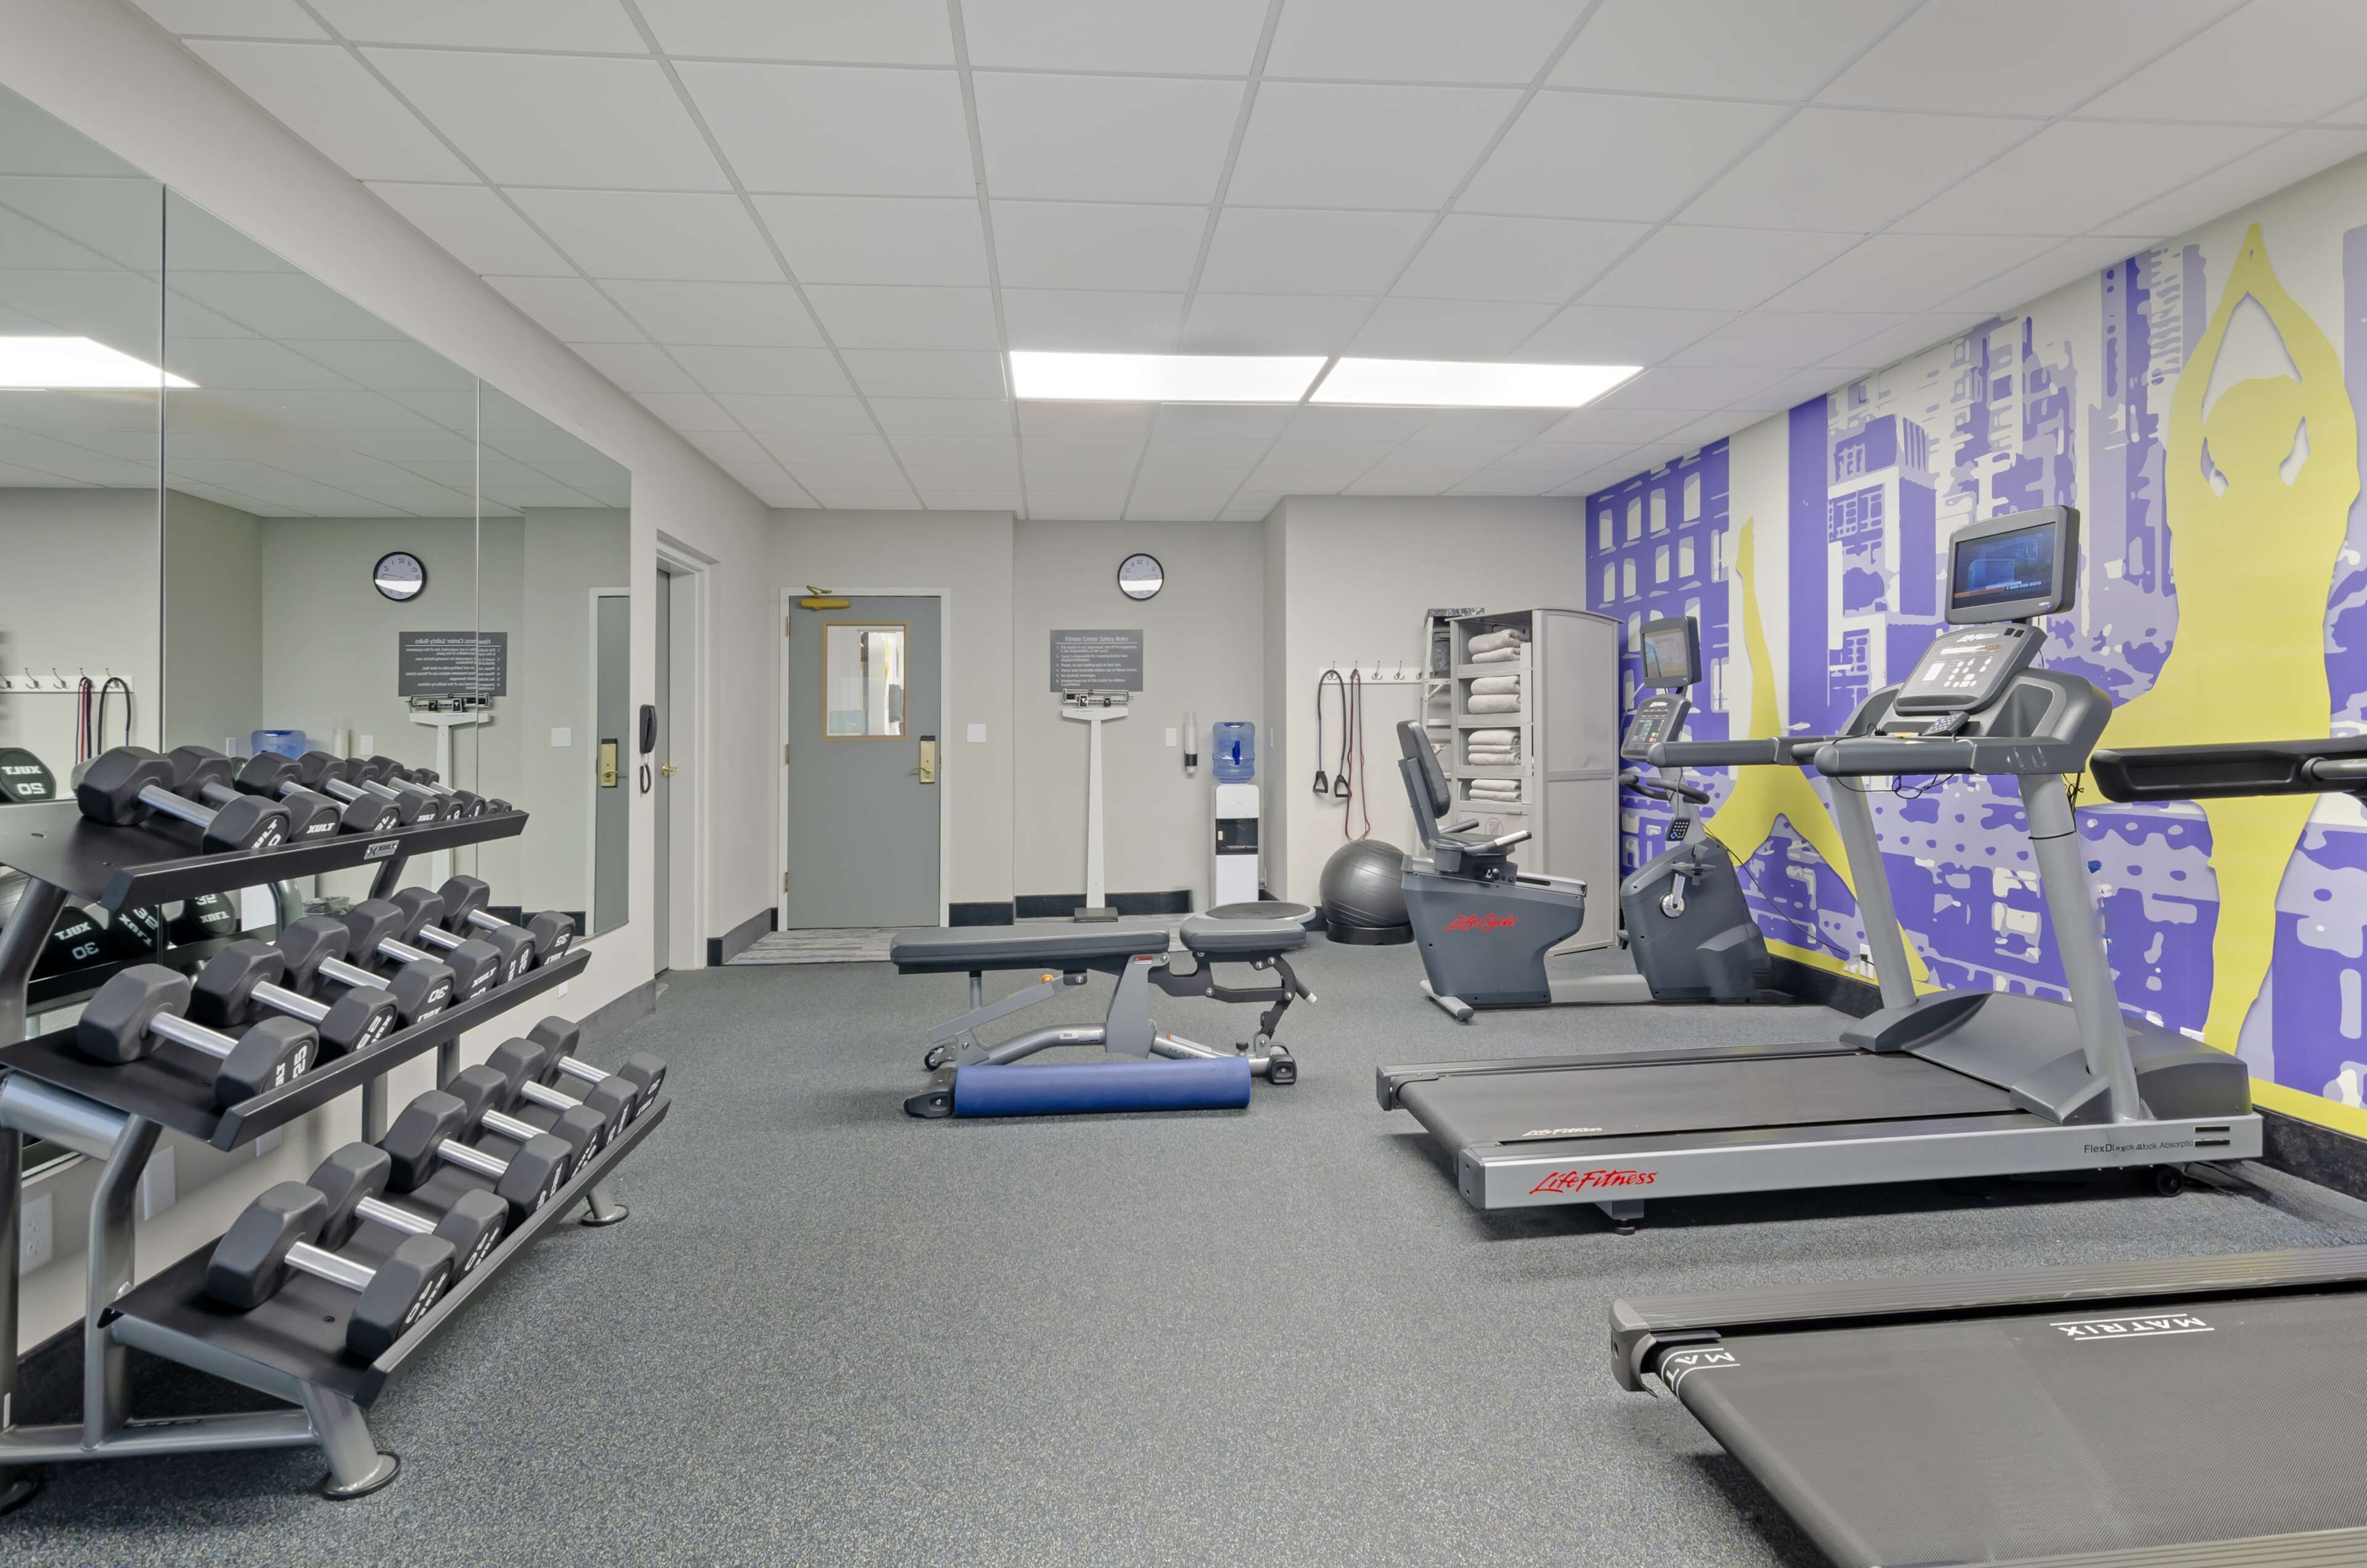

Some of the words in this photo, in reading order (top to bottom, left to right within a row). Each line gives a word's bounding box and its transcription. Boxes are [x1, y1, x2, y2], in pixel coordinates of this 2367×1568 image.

[251, 819, 277, 849] ULT
[306, 822, 335, 834] XULT
[471, 966, 497, 988] XULT
[427, 985, 449, 1004] 30
[292, 1045, 308, 1079] 25
[2159, 1139, 2194, 1149] Absorptio
[414, 1272, 448, 1323] XUL
[2058, 1317, 2206, 1336] MATRIX
[1665, 1352, 1736, 1392] MAT
